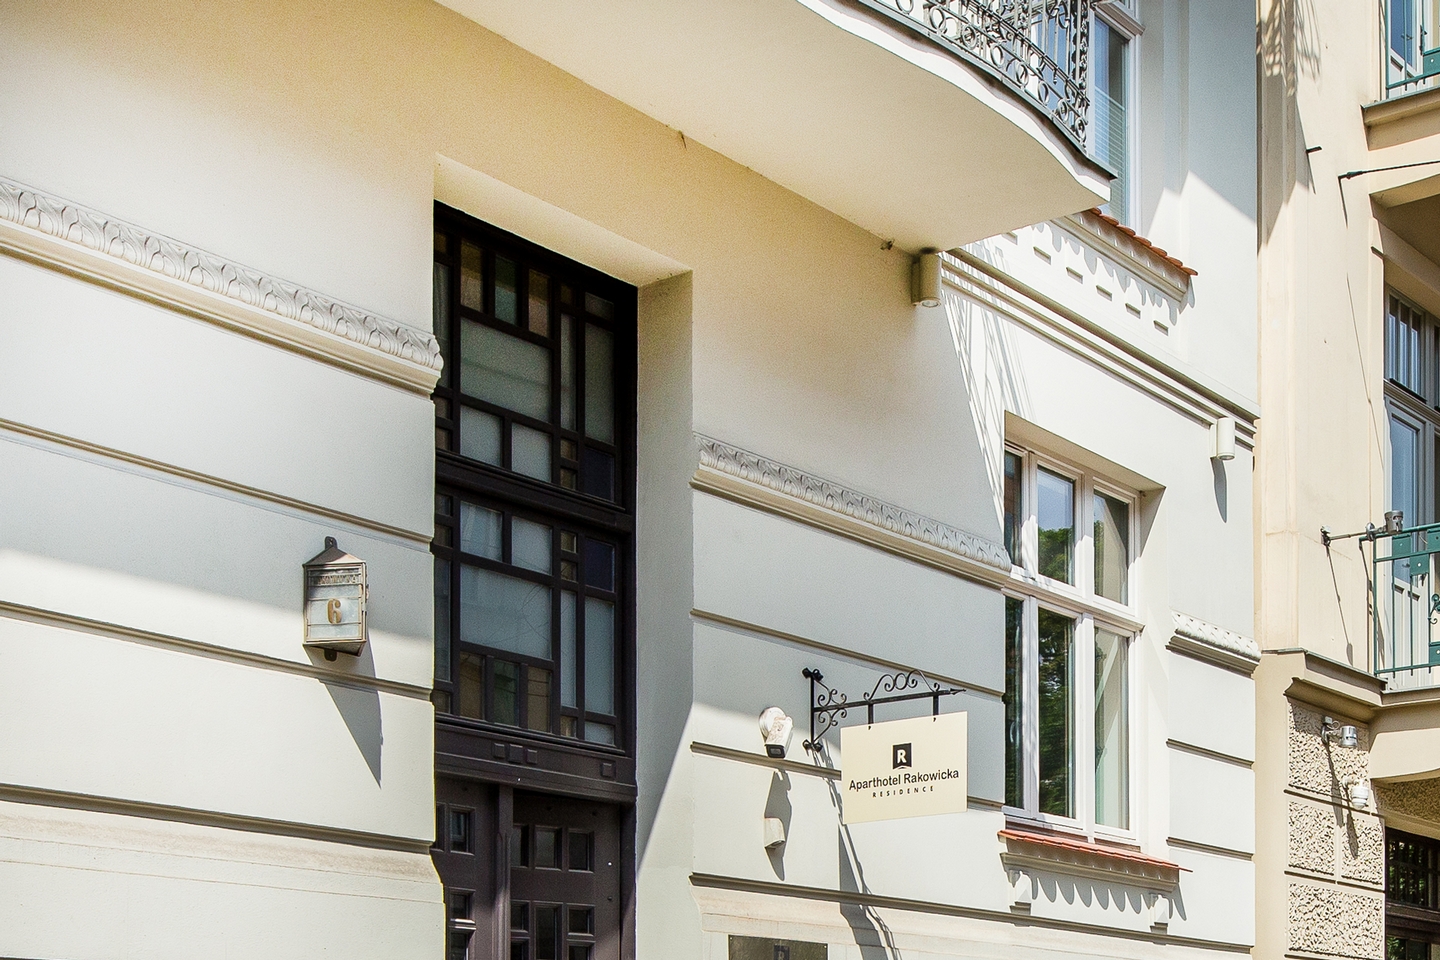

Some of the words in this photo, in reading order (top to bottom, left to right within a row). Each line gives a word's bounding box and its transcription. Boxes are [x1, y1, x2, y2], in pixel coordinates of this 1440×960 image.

[327, 598, 341, 624] 6
[897, 749, 907, 763] R
[849, 774, 901, 792] Aparthotel
[903, 769, 959, 784] Rakowicka
[872, 785, 934, 798] RESIDENCE
